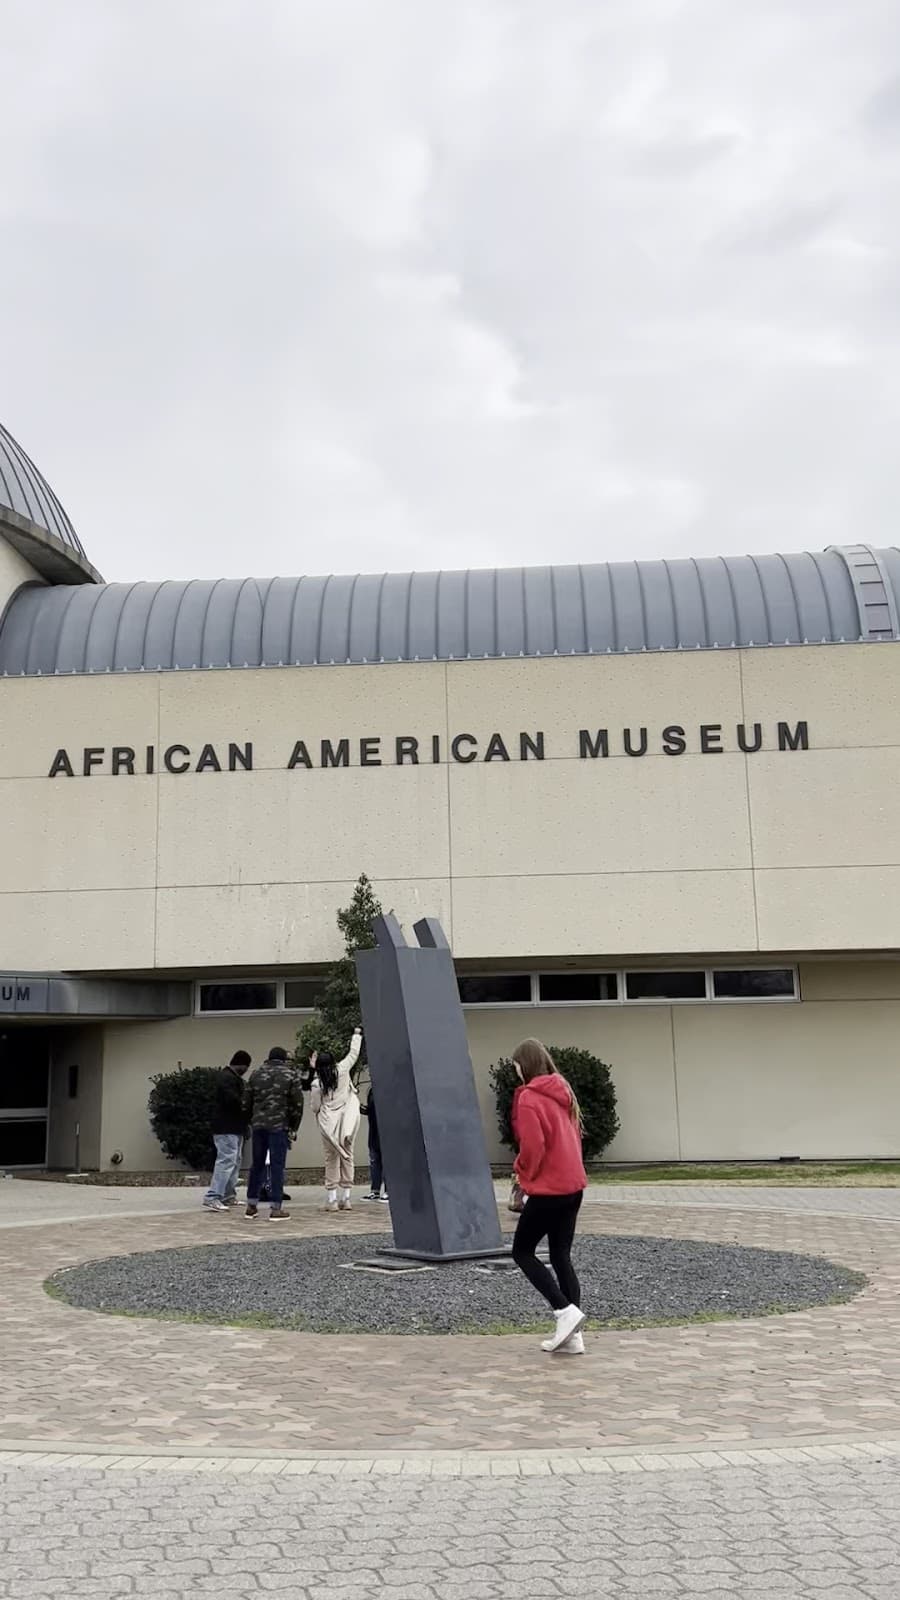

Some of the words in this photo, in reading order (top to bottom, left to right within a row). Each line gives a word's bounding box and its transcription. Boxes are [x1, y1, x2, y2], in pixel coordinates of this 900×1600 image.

[48, 742, 254, 778] AFRICAN
[287, 731, 546, 770] AMERICAN
[578, 721, 810, 759] MUSEUM
